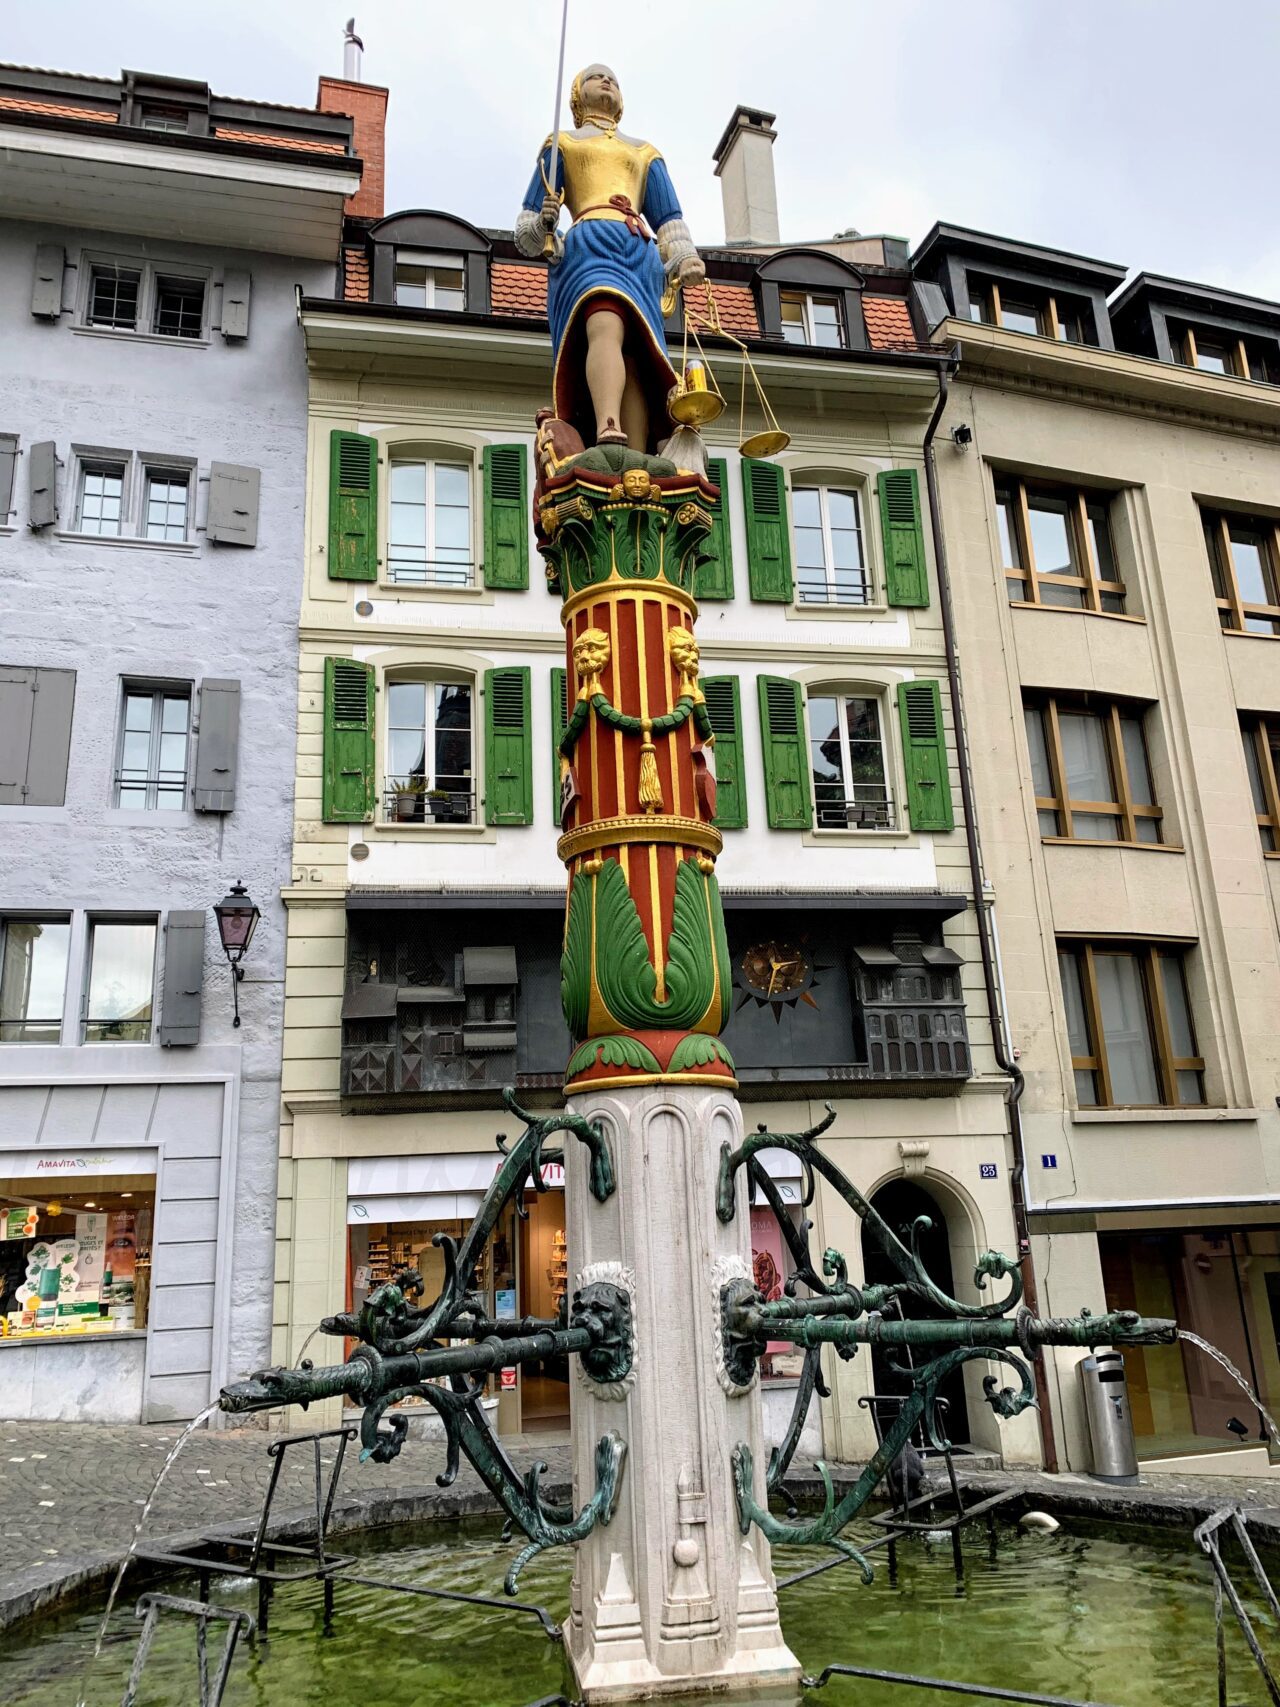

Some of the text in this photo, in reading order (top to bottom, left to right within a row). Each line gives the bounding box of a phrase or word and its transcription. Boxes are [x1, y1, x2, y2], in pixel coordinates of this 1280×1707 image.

[37, 1160, 76, 1169] AMAVITA
[1046, 1156, 1053, 1167] 1
[982, 1165, 996, 1177] 23
